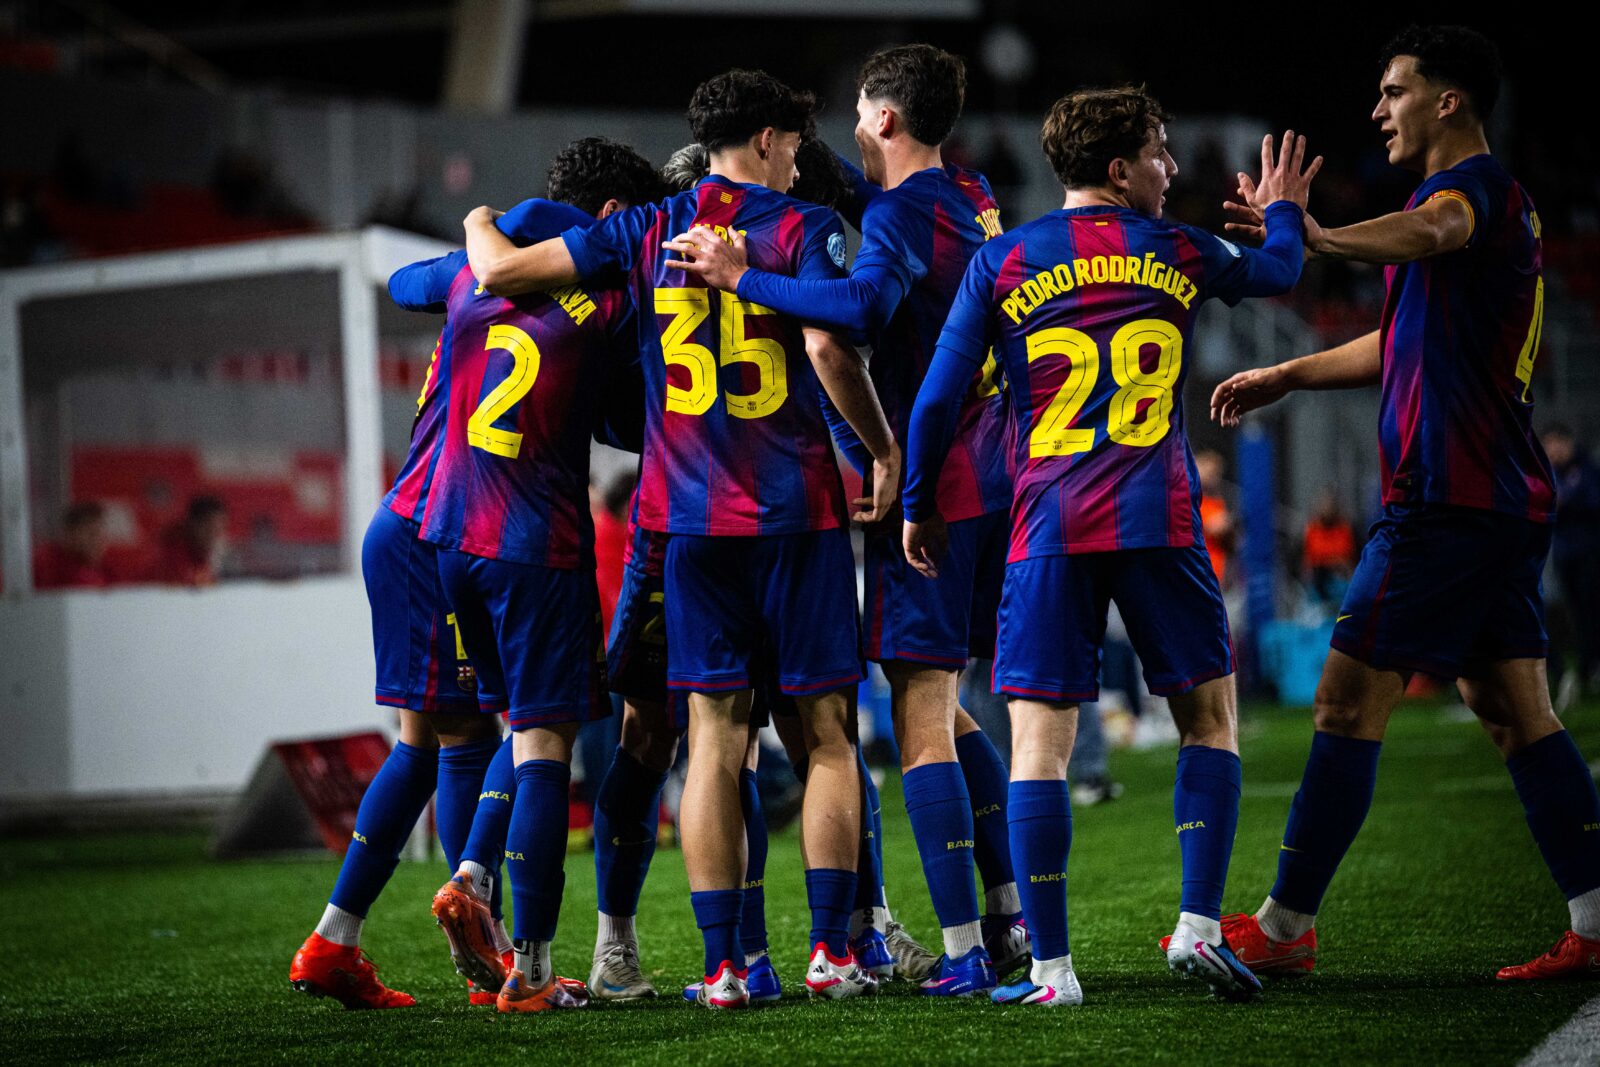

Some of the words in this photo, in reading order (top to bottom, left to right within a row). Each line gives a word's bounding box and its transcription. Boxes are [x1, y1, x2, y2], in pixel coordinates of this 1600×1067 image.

[653, 286, 789, 419] 35
[1001, 263, 1075, 325] PEDRO
[1073, 252, 1199, 311] RODRÍGUEZ
[467, 324, 541, 460] 2
[1026, 318, 1184, 459] 28
[1030, 872, 1067, 884] BARÇA
